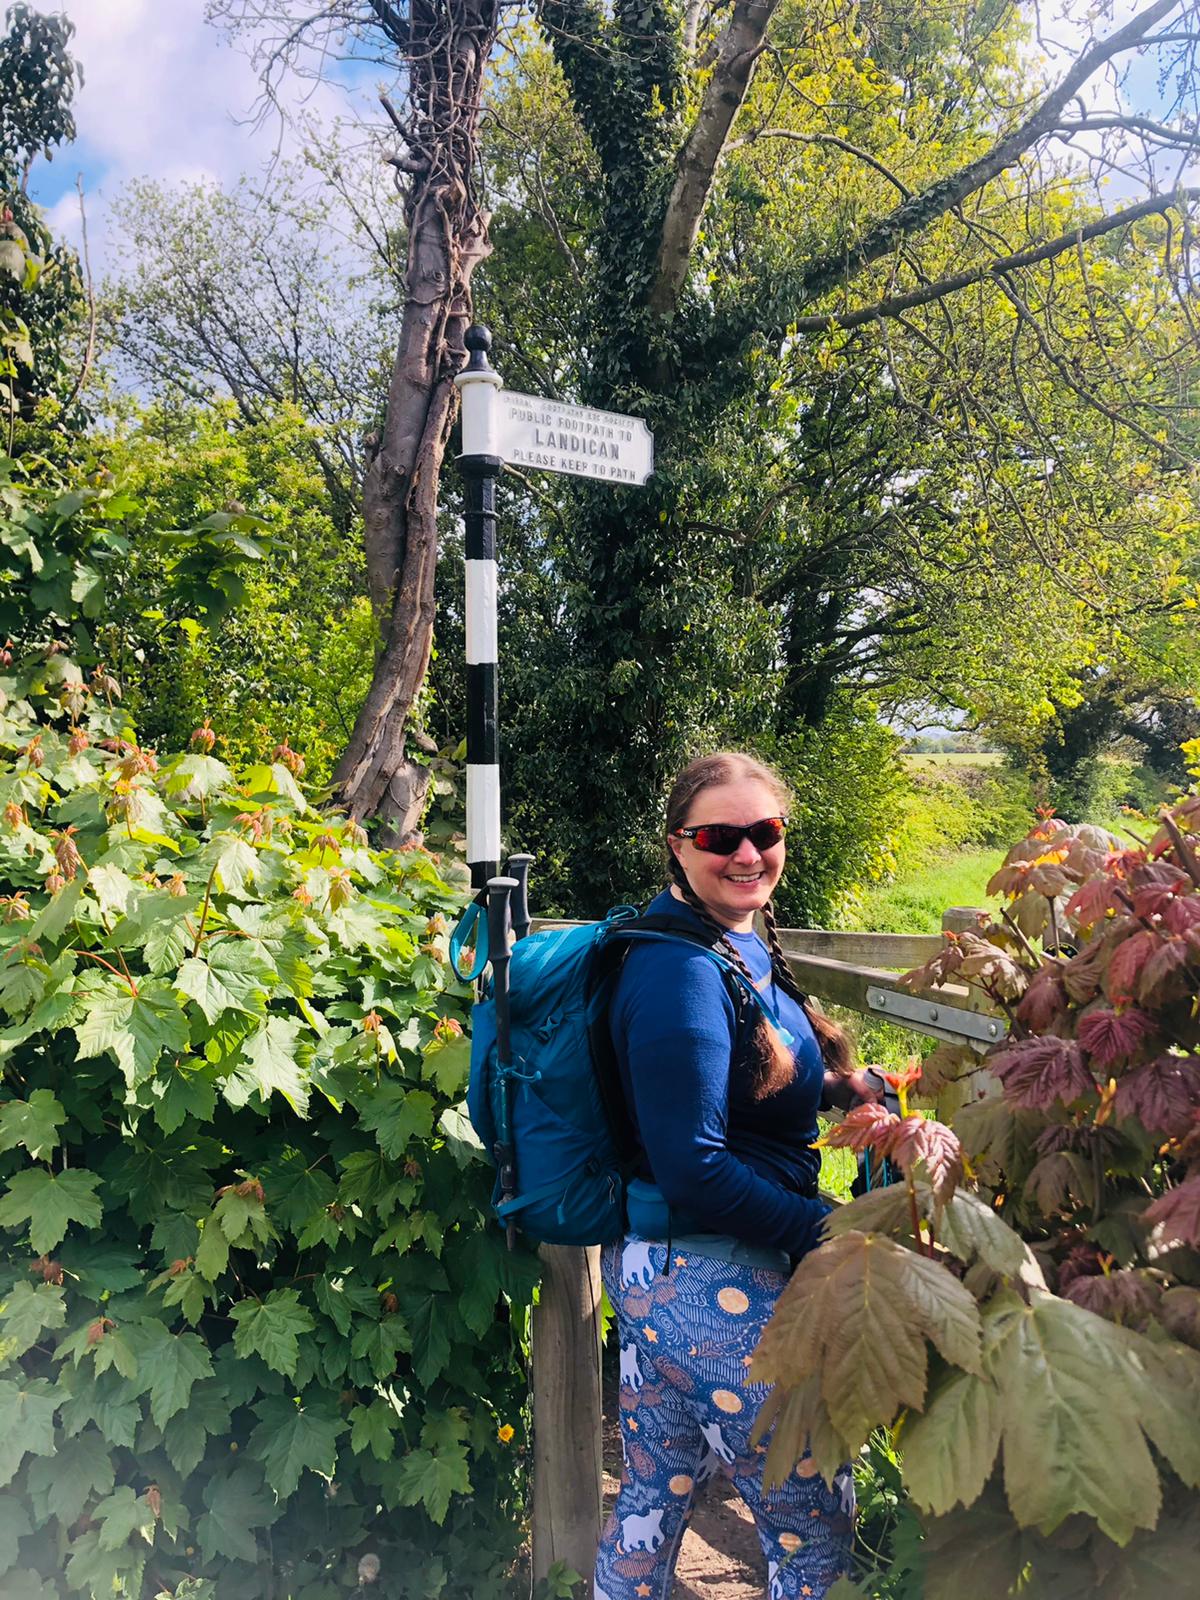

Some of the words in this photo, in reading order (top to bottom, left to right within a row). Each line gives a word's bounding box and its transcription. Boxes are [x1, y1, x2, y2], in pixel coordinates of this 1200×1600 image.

[510, 408, 552, 426] PUBLIC
[558, 418, 613, 438] FOOTPATH
[620, 430, 632, 442] TO
[536, 429, 619, 459] LANDICAN
[514, 449, 555, 466] PLEASE
[562, 459, 587, 471] KEEP
[593, 464, 606, 475] TO
[611, 466, 636, 480] PATH
